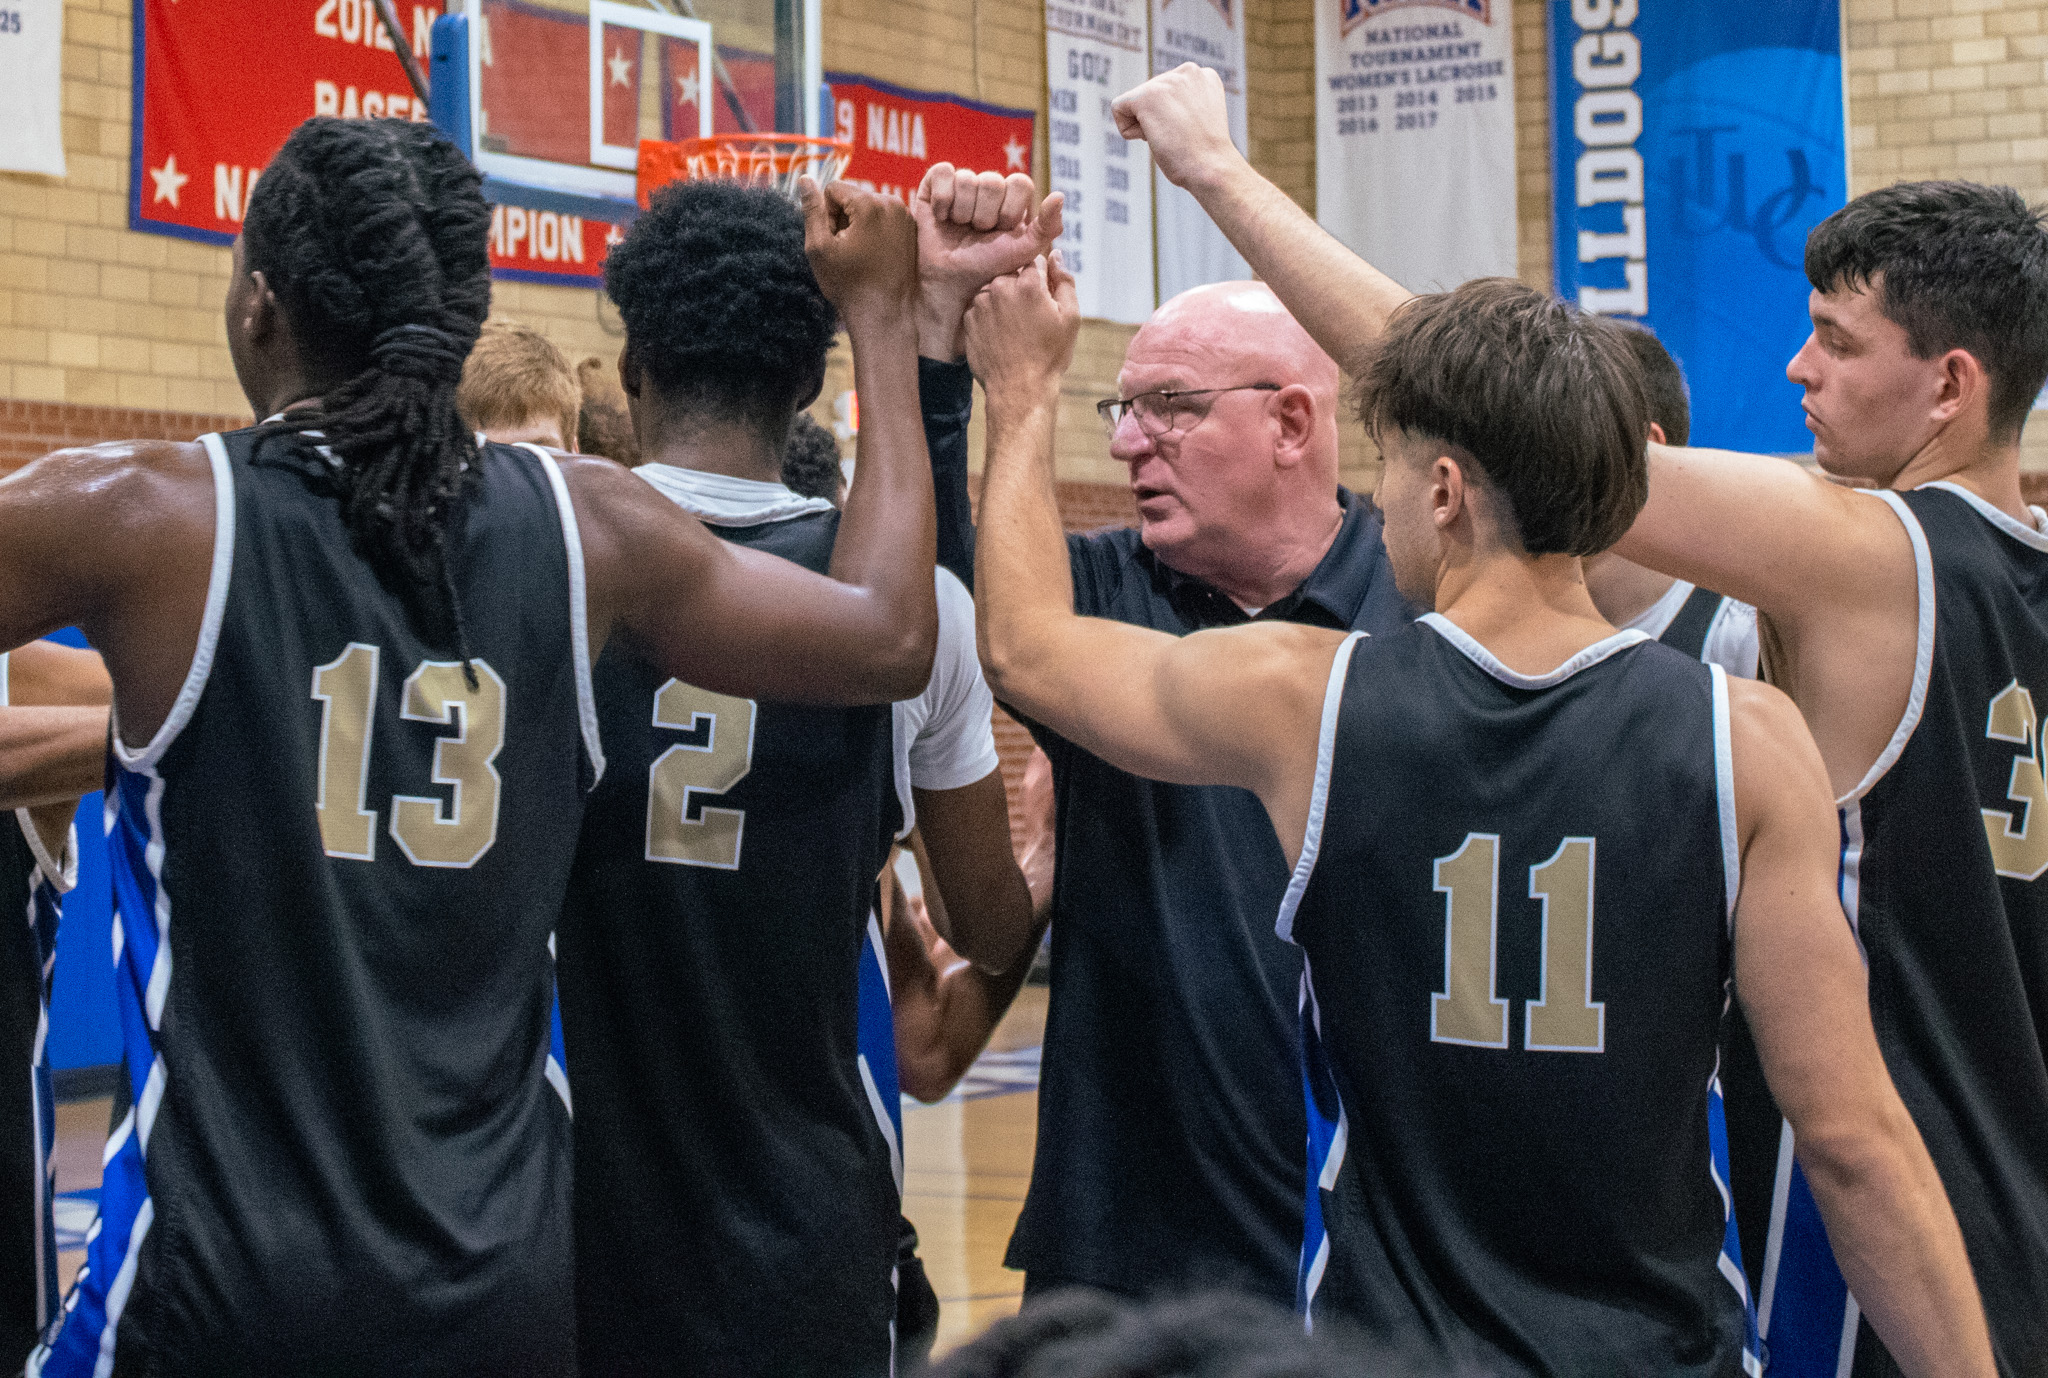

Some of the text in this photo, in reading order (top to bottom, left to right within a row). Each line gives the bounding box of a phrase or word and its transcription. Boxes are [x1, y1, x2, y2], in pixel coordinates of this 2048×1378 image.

[1350, 41, 1482, 69] TOURNAMENT
[1365, 21, 1464, 45] NATIONAL
[1328, 59, 1505, 91] WOMEN'S LACROSSE
[1337, 83, 1498, 114] 2013 2014 2015
[867, 102, 928, 160] NAIA
[1337, 110, 1438, 135] 2016 2017
[311, 641, 507, 868] 13
[645, 677, 757, 870] 2
[1980, 678, 2048, 882] 3
[1430, 832, 1605, 1053] 11
